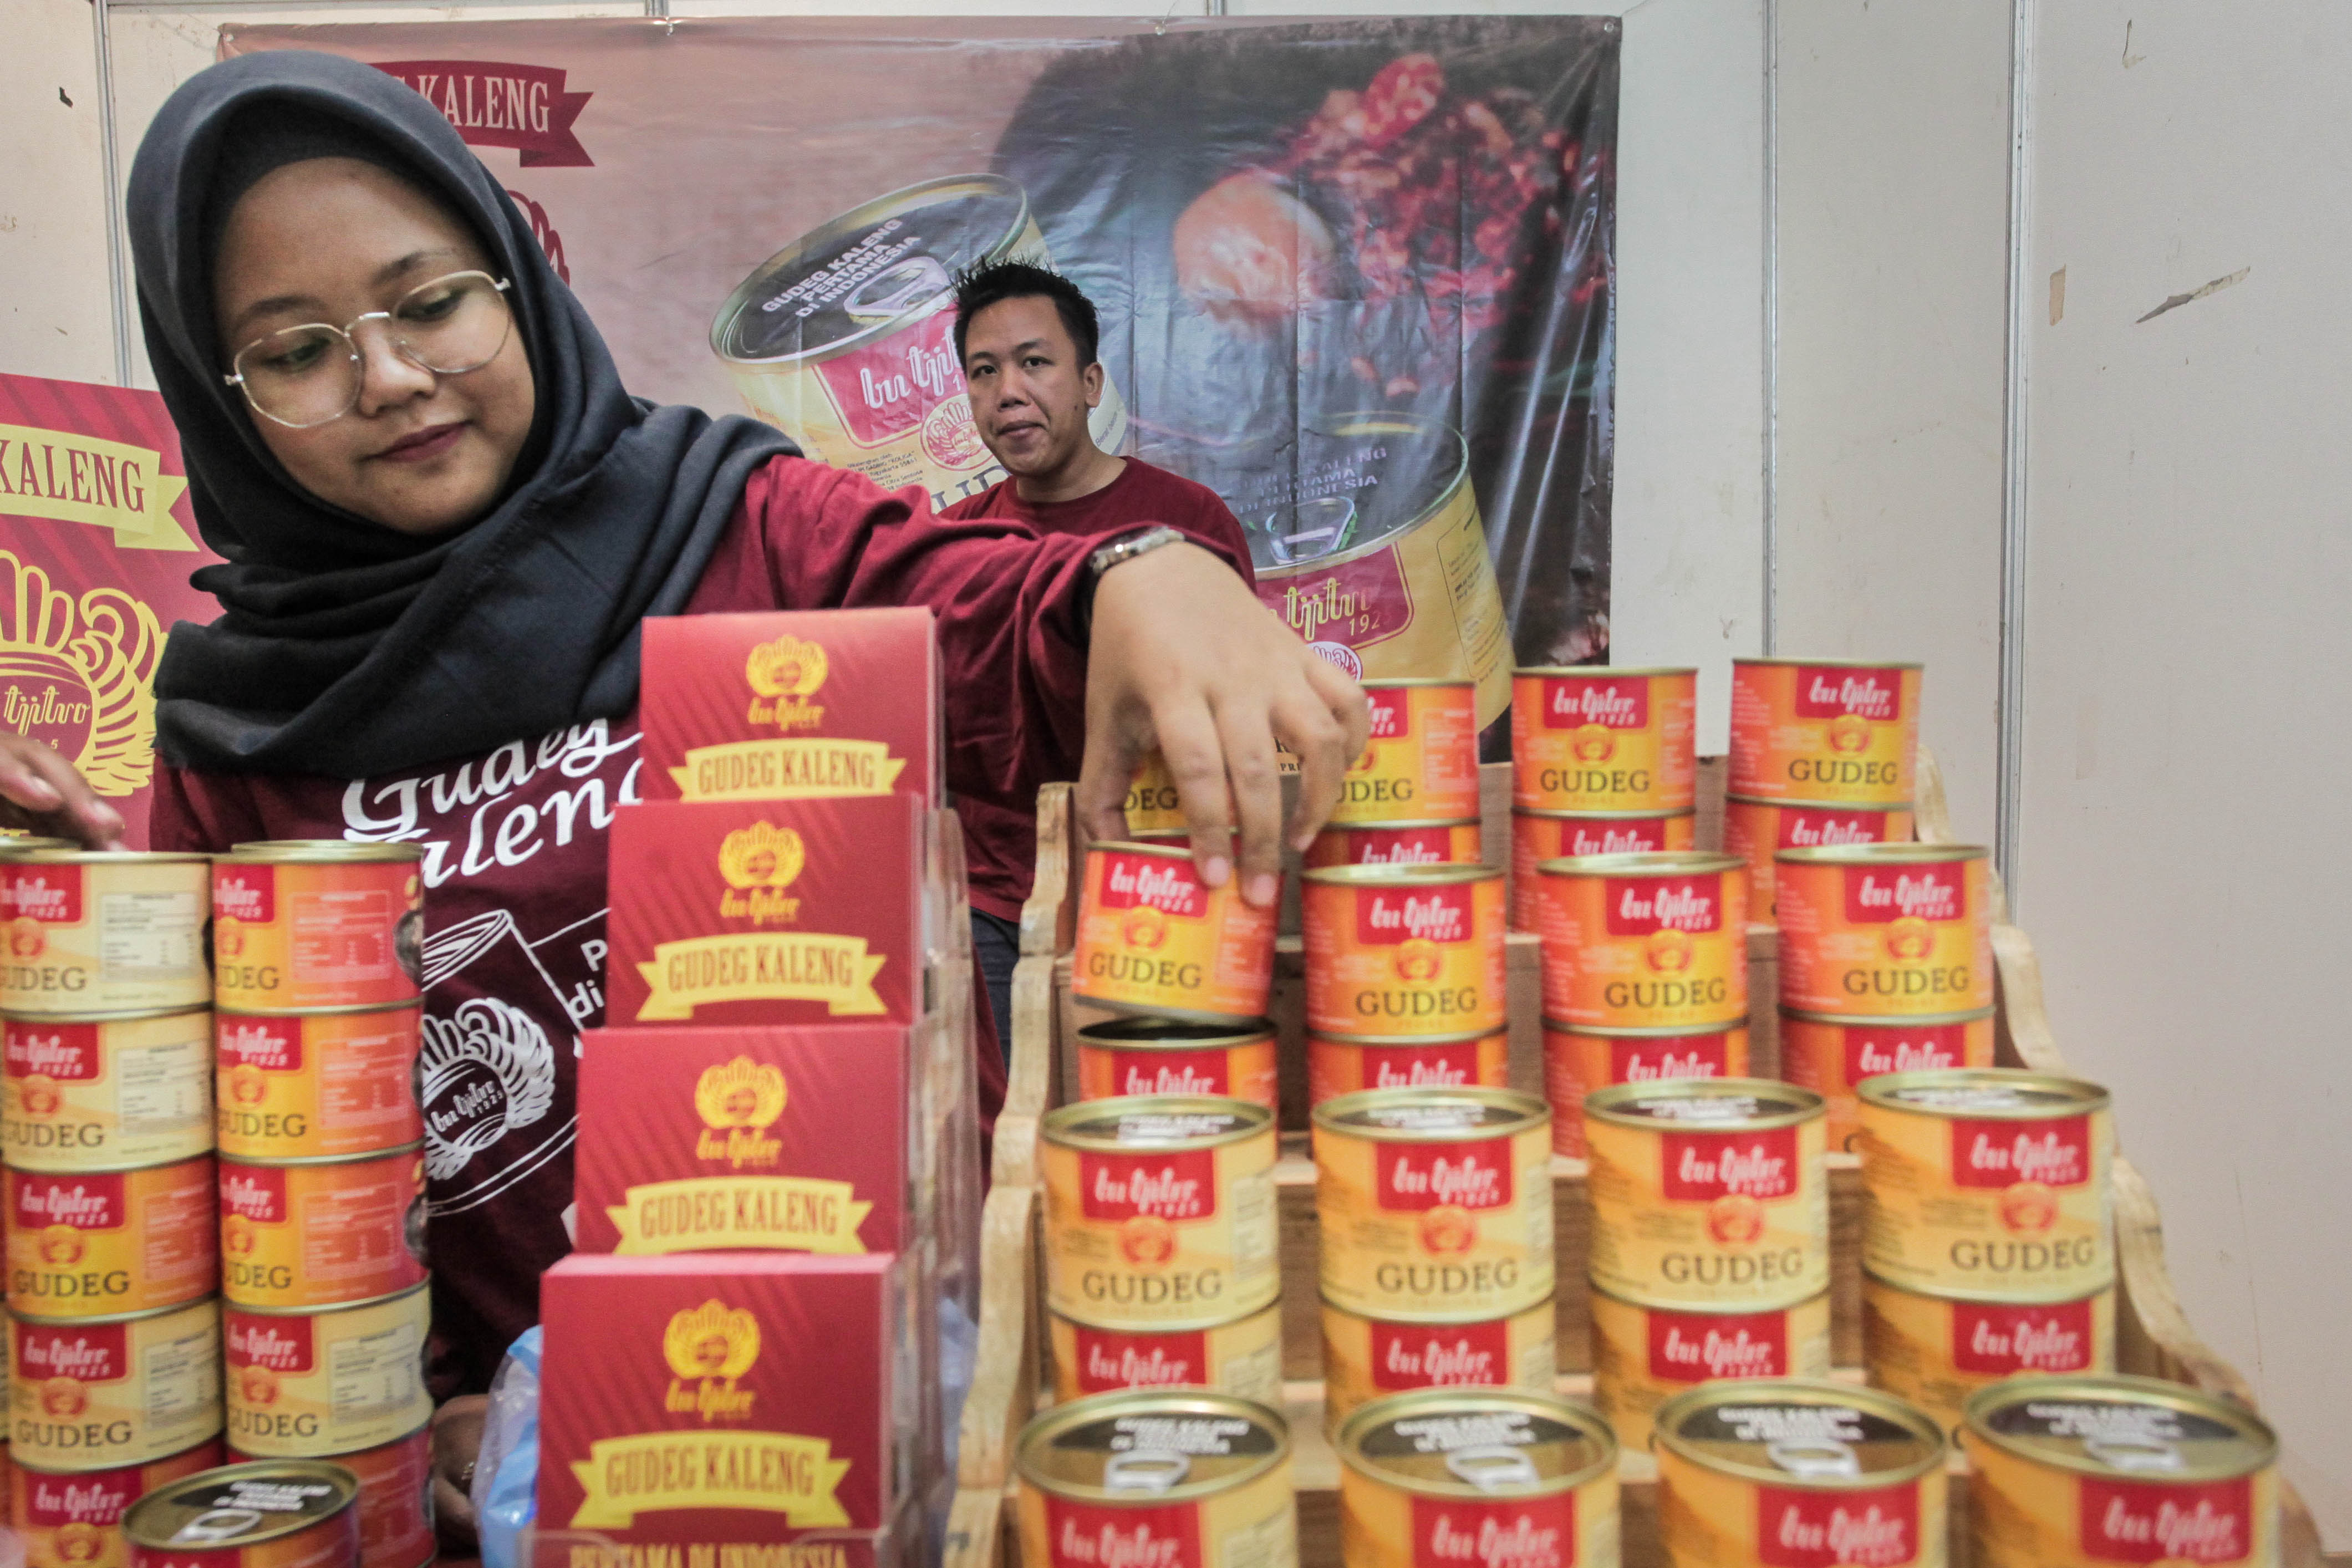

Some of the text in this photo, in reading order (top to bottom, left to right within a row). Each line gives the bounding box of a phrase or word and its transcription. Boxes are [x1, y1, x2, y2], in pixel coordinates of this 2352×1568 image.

[762, 219, 903, 312] GUDEG KALENG
[796, 237, 921, 317] DI INDONESIA
[801, 245, 891, 301] PERTAMA
[698, 749, 874, 793] GUDEG KALENG
[1541, 769, 1650, 793] GUDEG
[1789, 760, 1897, 786] GUDEG
[668, 946, 853, 992] GUDEG KALENG
[1090, 952, 1203, 989] GUDEG
[1843, 967, 1969, 995] GUDEG
[1356, 988, 1478, 1016] GUDEG
[1605, 978, 1727, 1008] GUDEG
[640, 1184, 838, 1239] GUDEG KALENG
[1662, 1249, 1803, 1284] GUDEG
[1951, 1236, 2094, 1272] GUDEG
[1083, 1269, 1223, 1304] GUDEG
[1376, 1258, 1518, 1295] GUDEG
[605, 1446, 814, 1498] GUDEG KALENG
